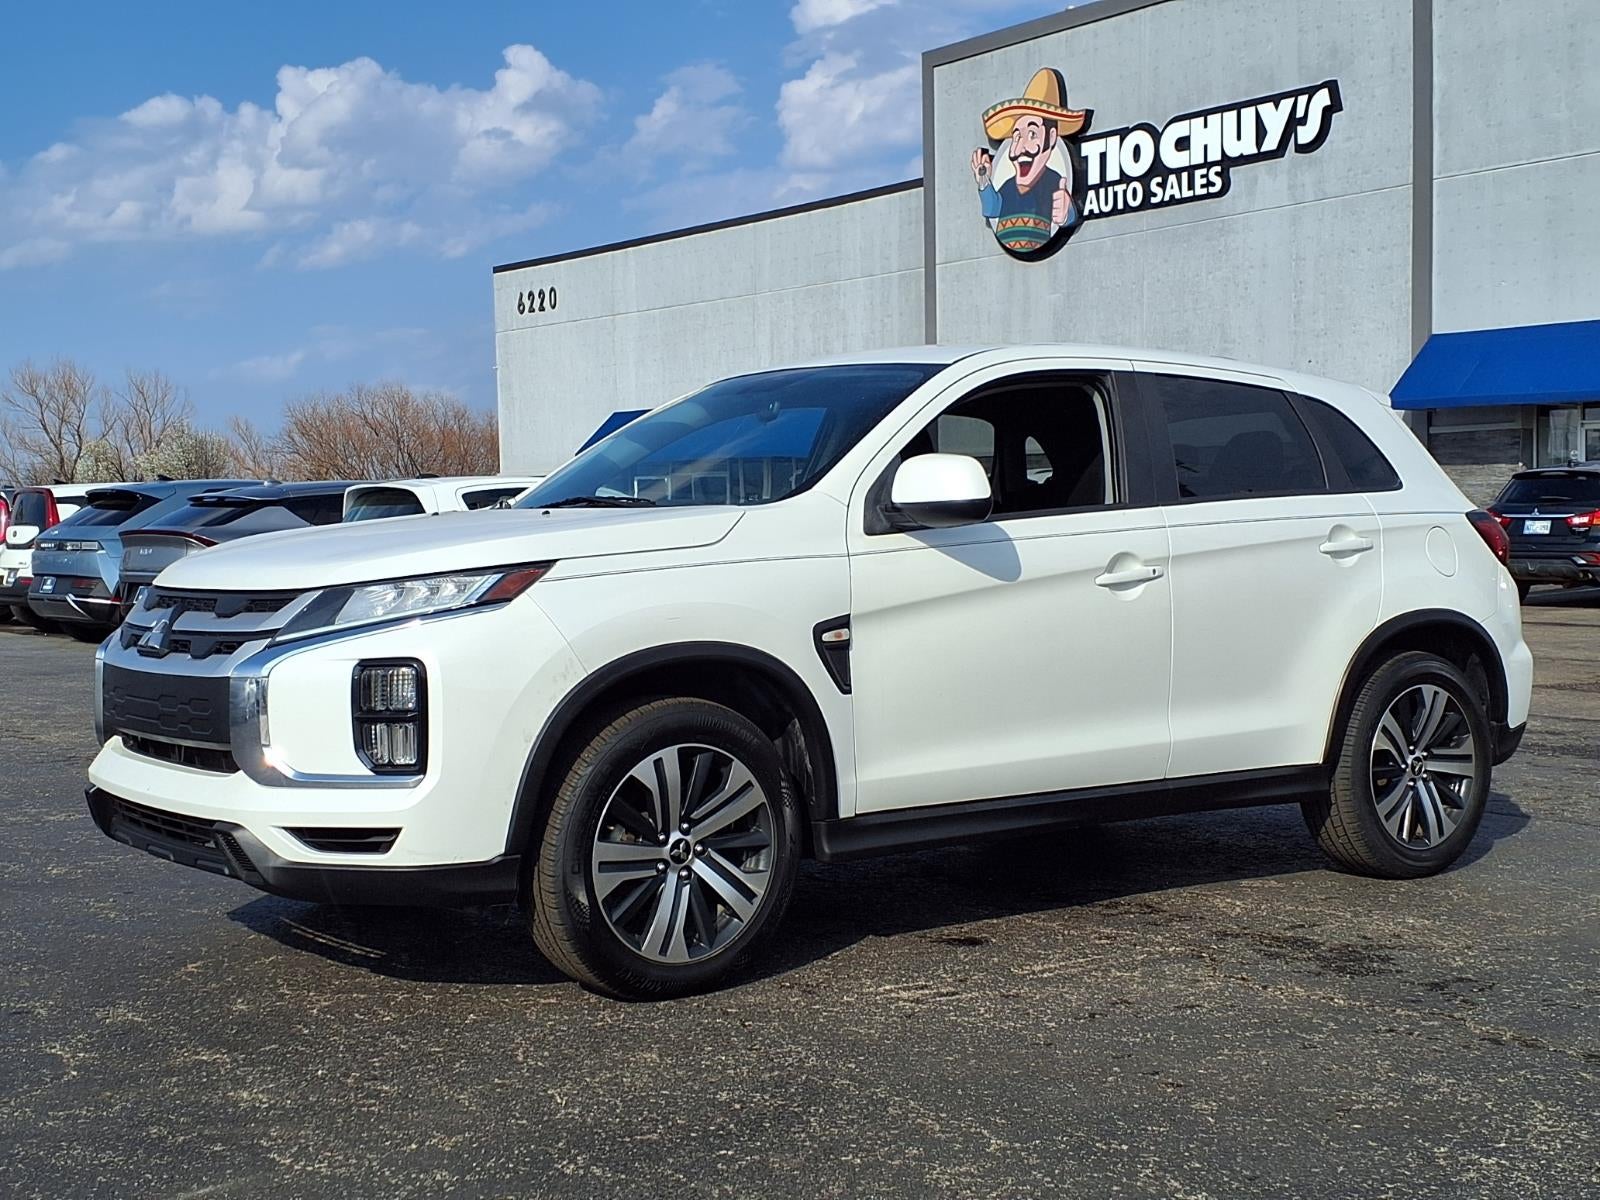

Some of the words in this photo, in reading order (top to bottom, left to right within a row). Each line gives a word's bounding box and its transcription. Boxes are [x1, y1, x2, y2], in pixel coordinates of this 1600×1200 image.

[1081, 129, 1155, 186] TIO
[1160, 87, 1332, 168] CHUY'S
[1083, 181, 1143, 216] AUTO
[1150, 165, 1223, 203] SALES
[517, 286, 557, 315] 6220
